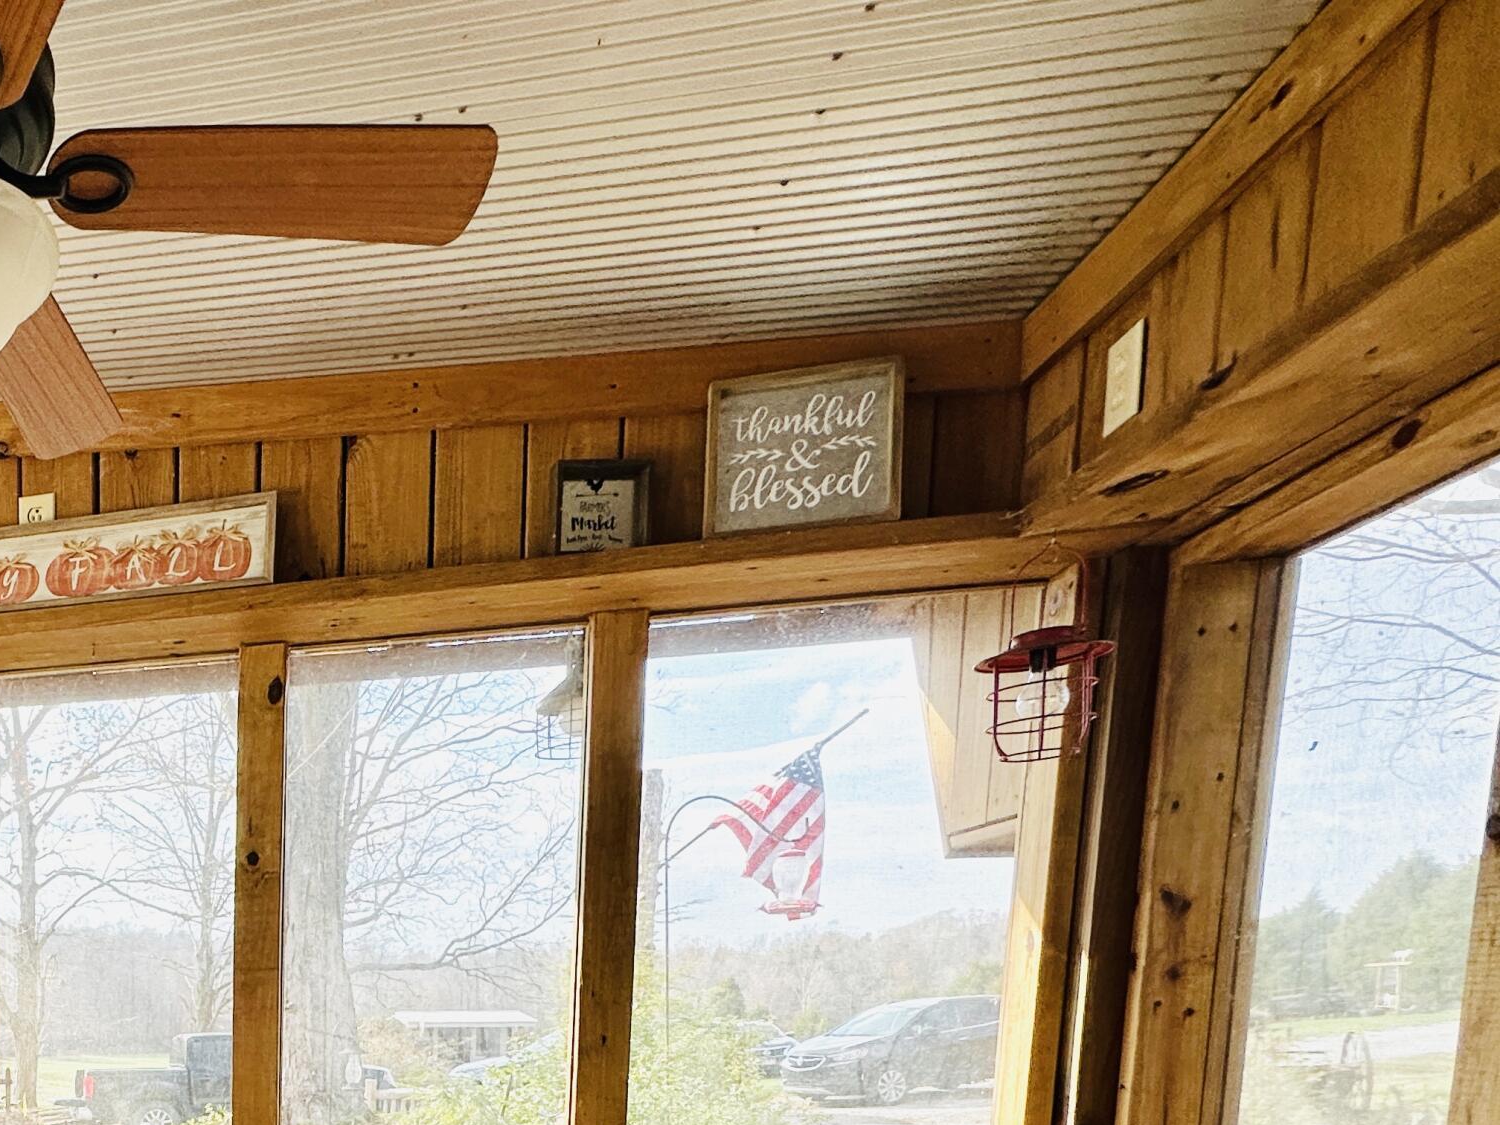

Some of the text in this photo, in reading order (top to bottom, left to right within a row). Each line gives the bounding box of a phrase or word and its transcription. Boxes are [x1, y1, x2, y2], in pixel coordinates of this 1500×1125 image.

[731, 389, 877, 444] thankful
[728, 449, 875, 513] blessed
[784, 438, 822, 473] &
[69, 540, 237, 592] FALL
